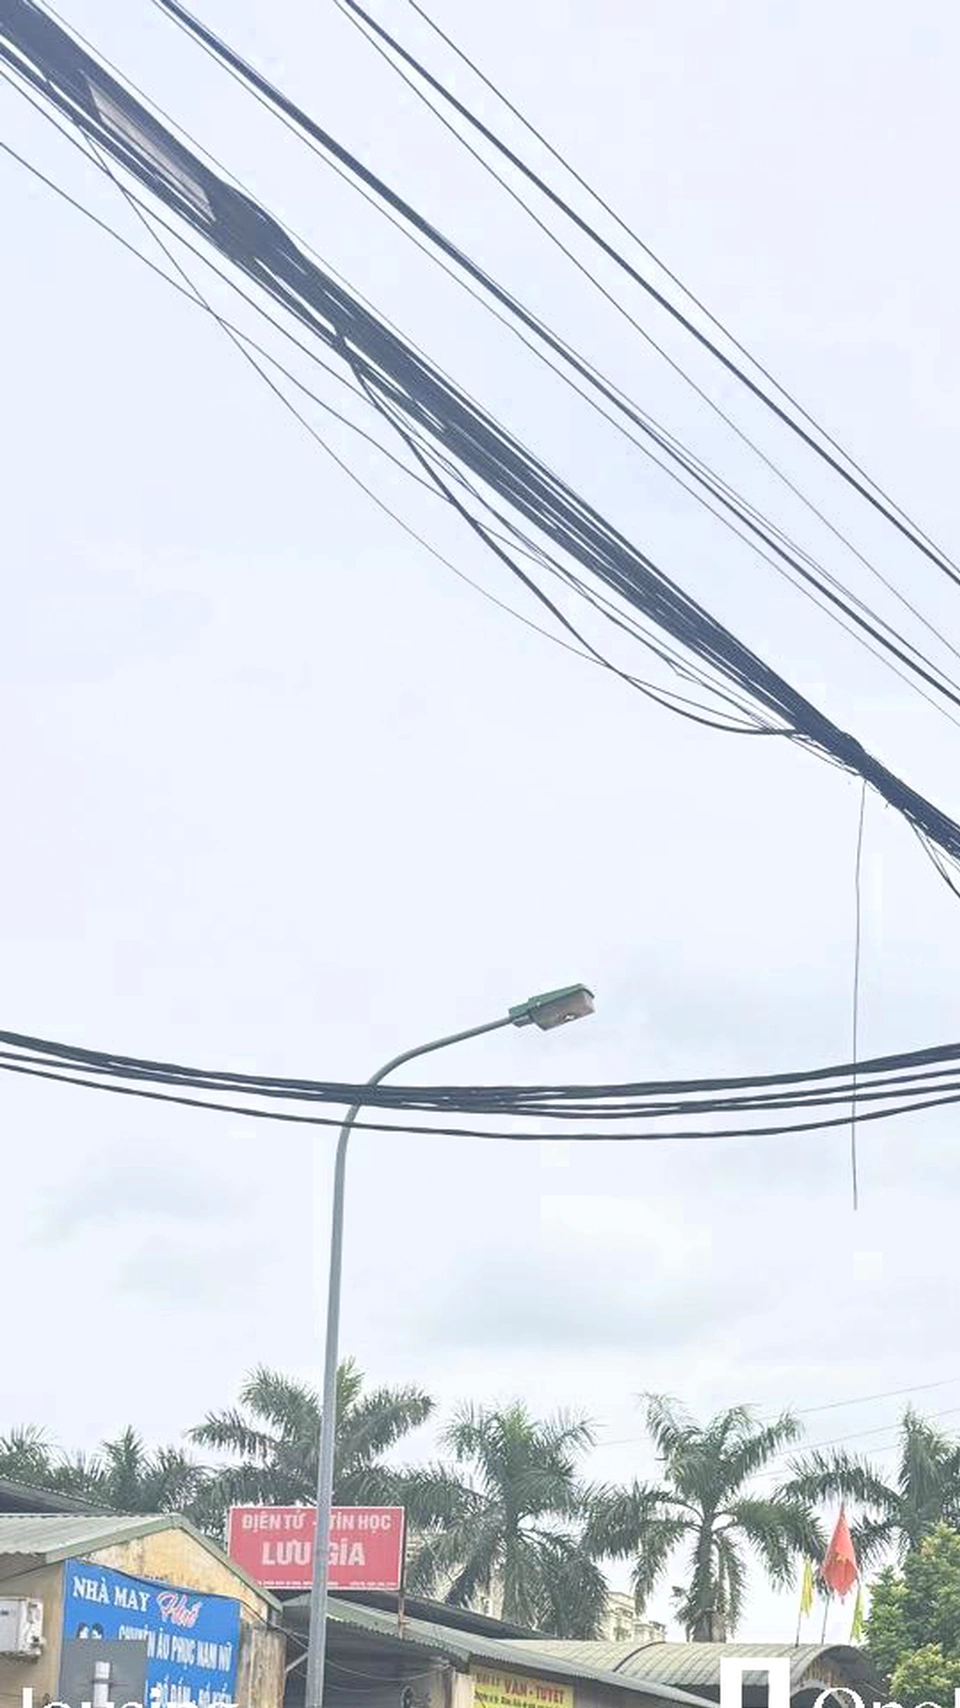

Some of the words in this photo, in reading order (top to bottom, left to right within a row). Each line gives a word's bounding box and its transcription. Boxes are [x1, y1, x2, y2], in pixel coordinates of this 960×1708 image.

[357, 1514, 392, 1534] HỌC
[262, 1540, 313, 1566] LƯU
[73, 1576, 110, 1606] NHÀ
[114, 1585, 151, 1612] MAY
[197, 1640, 218, 1670] NAM
